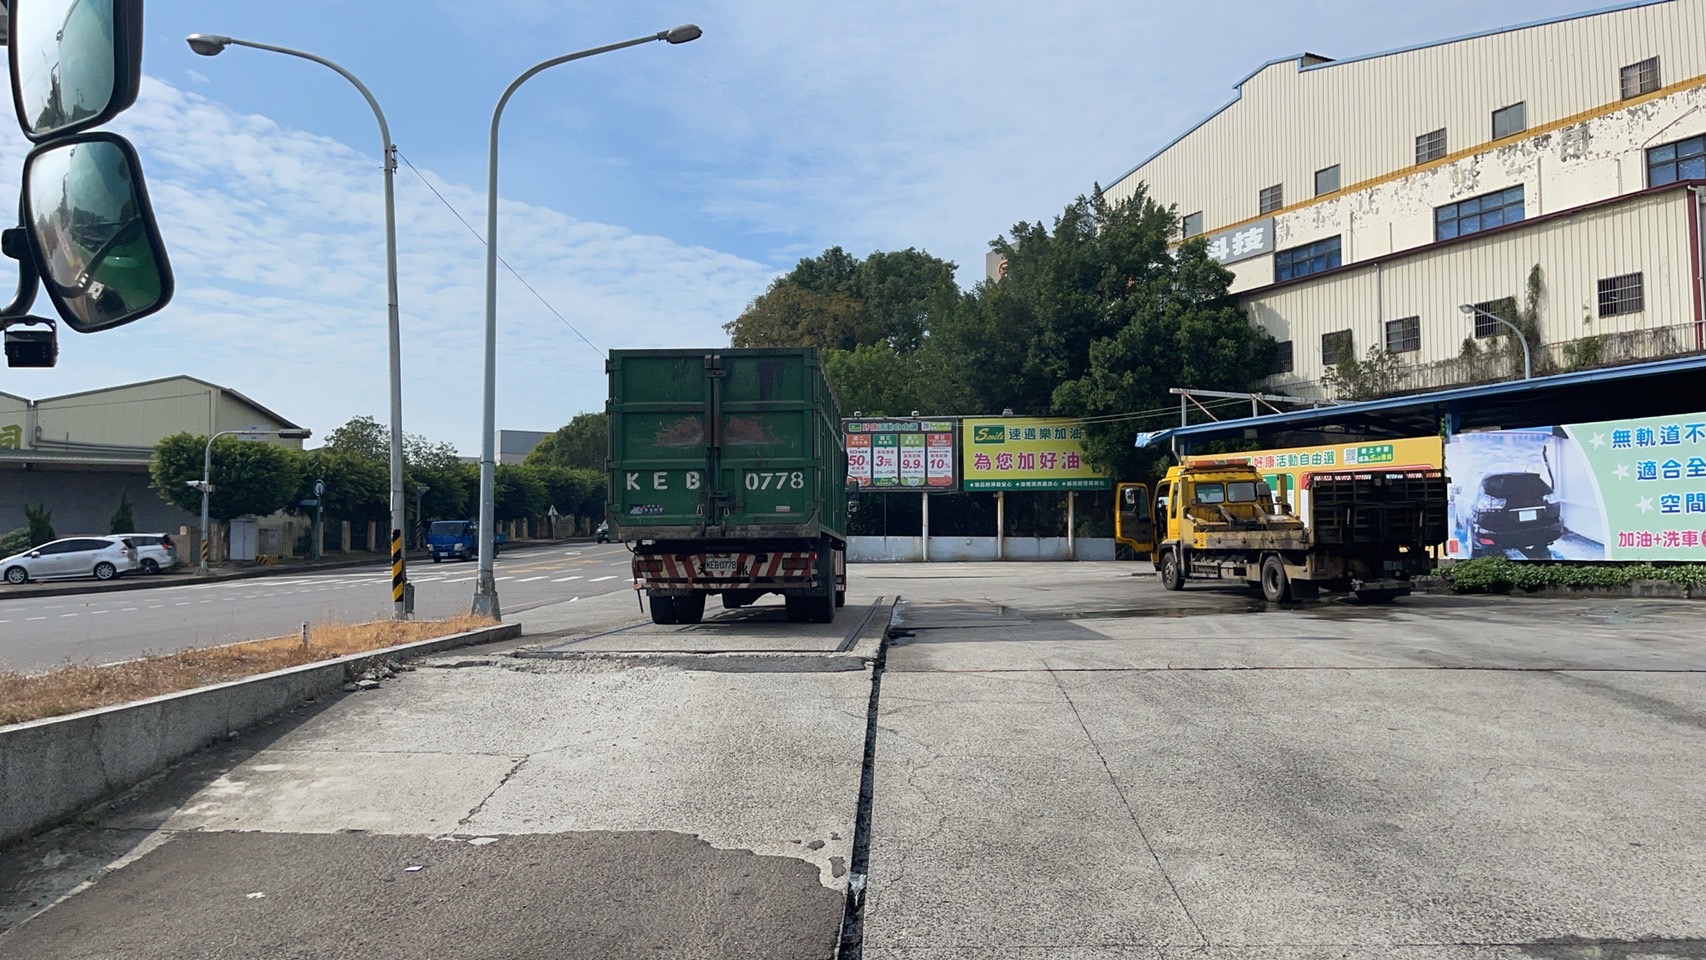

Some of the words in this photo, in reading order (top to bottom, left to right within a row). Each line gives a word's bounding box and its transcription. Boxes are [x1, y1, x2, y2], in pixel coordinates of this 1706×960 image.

[975, 428, 1004, 442] Smile
[1009, 427, 1082, 440] 速邁樂加油
[1612, 423, 1706, 449] 無軌道不
[974, 451, 1080, 471] 為您加好油
[1254, 451, 1335, 468] 好康活動自由選
[1637, 457, 1706, 480] 適合全
[745, 471, 805, 490] 0778
[1660, 493, 1706, 514] 空間
[1618, 531, 1699, 547] 加油+洗車
